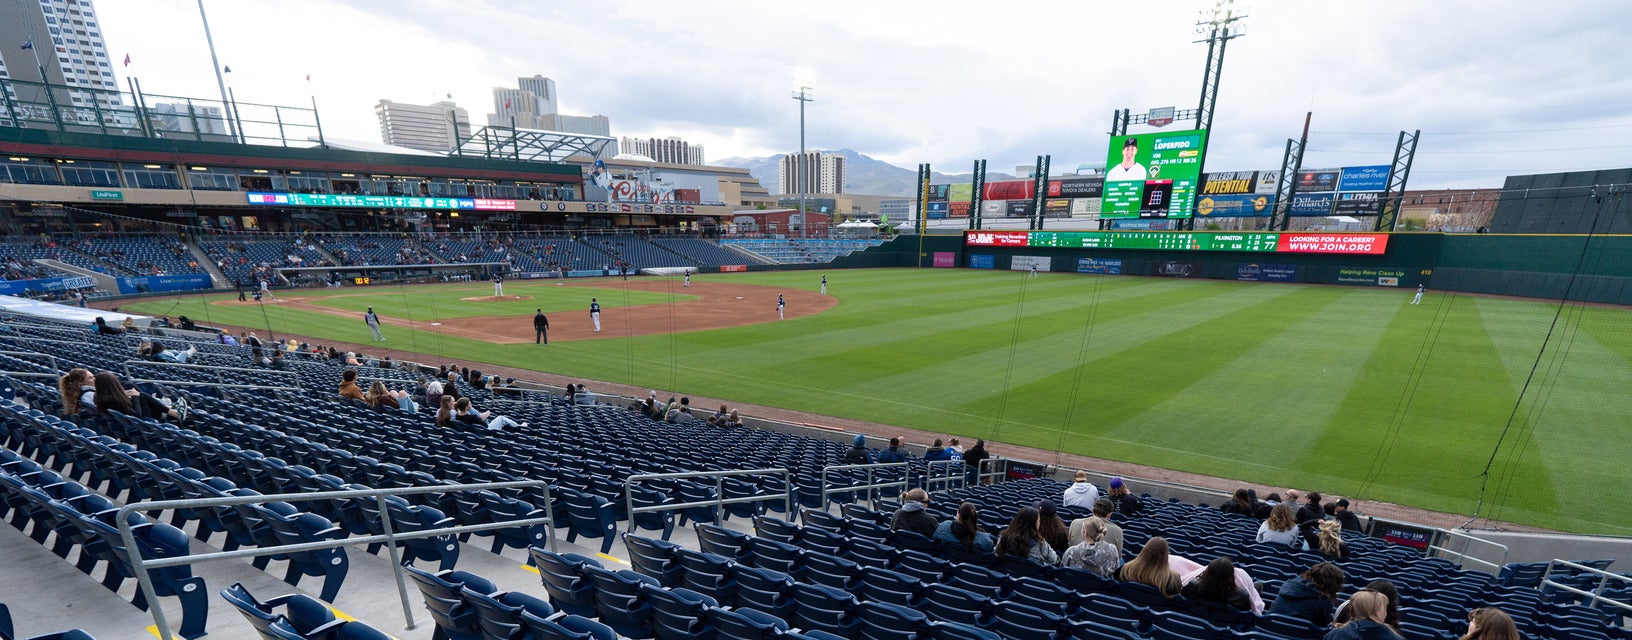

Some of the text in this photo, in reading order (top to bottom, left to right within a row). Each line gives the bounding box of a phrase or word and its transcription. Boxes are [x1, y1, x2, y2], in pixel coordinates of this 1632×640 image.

[1154, 141, 1190, 150] LOPERFIDO
[1207, 172, 1235, 180] UNLEASH
[1203, 179, 1251, 194] POTENTIAL
[1350, 193, 1378, 201] LITHIA
[1292, 197, 1330, 208] Dillard's
[1264, 242, 1275, 250] 77
[1290, 243, 1372, 251] WWW.JOIN.ORG
[64, 277, 94, 289] GREATER
